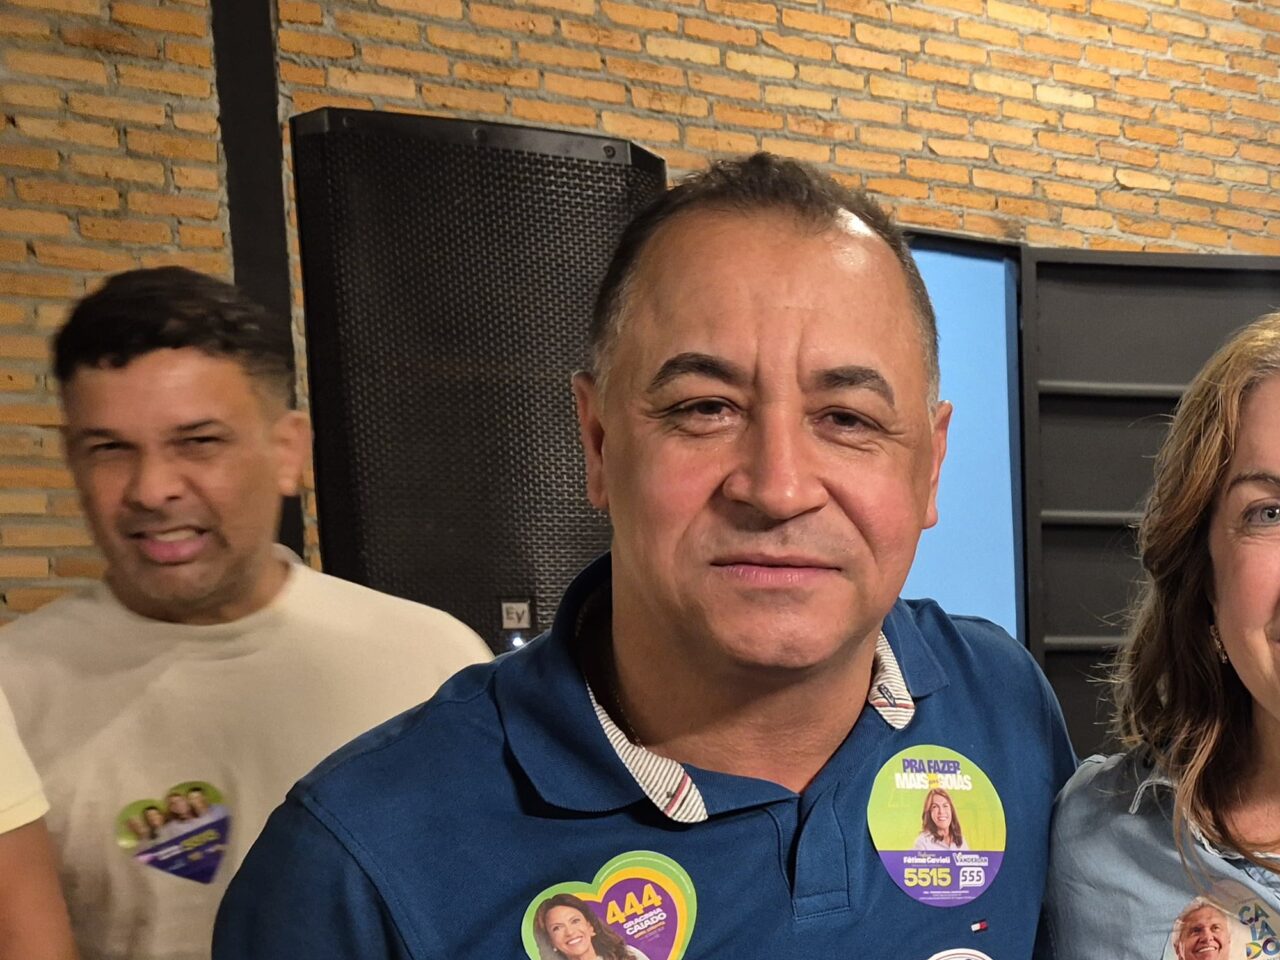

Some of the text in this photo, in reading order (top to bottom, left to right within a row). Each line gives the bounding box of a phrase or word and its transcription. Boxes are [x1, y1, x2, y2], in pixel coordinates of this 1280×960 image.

[902, 758, 961, 774] PRA FAZER
[894, 773, 928, 790] MAIS
[903, 867, 952, 887] 5515
[961, 870, 982, 882] 555
[606, 883, 662, 925] 444
[626, 912, 667, 935] CAIADO
